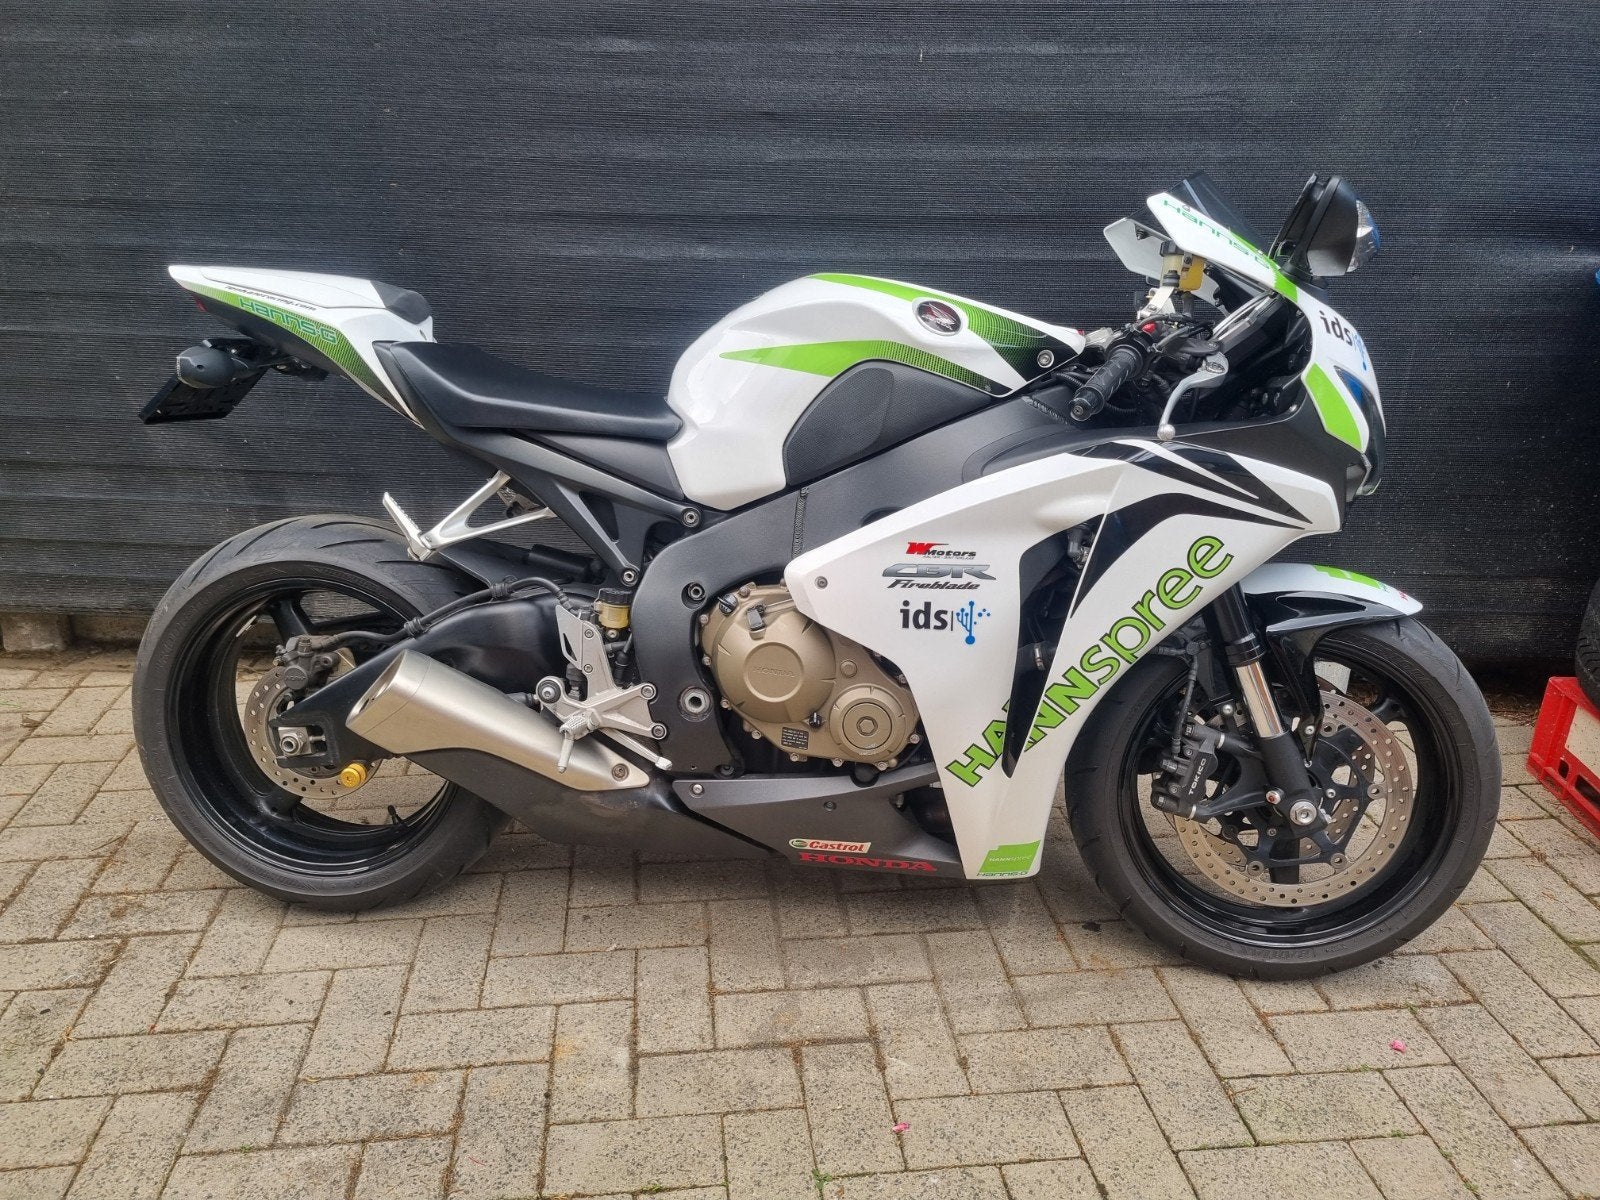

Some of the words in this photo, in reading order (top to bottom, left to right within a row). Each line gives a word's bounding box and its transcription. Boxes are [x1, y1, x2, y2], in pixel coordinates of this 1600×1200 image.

[1319, 310, 1353, 347] ids
[882, 563, 997, 581] CBR
[886, 579, 981, 590] Fireblade
[899, 599, 949, 631] ids
[1188, 758, 1207, 796] TOKICO
[808, 840, 866, 852] Castrol
[799, 851, 938, 873] HONDA
